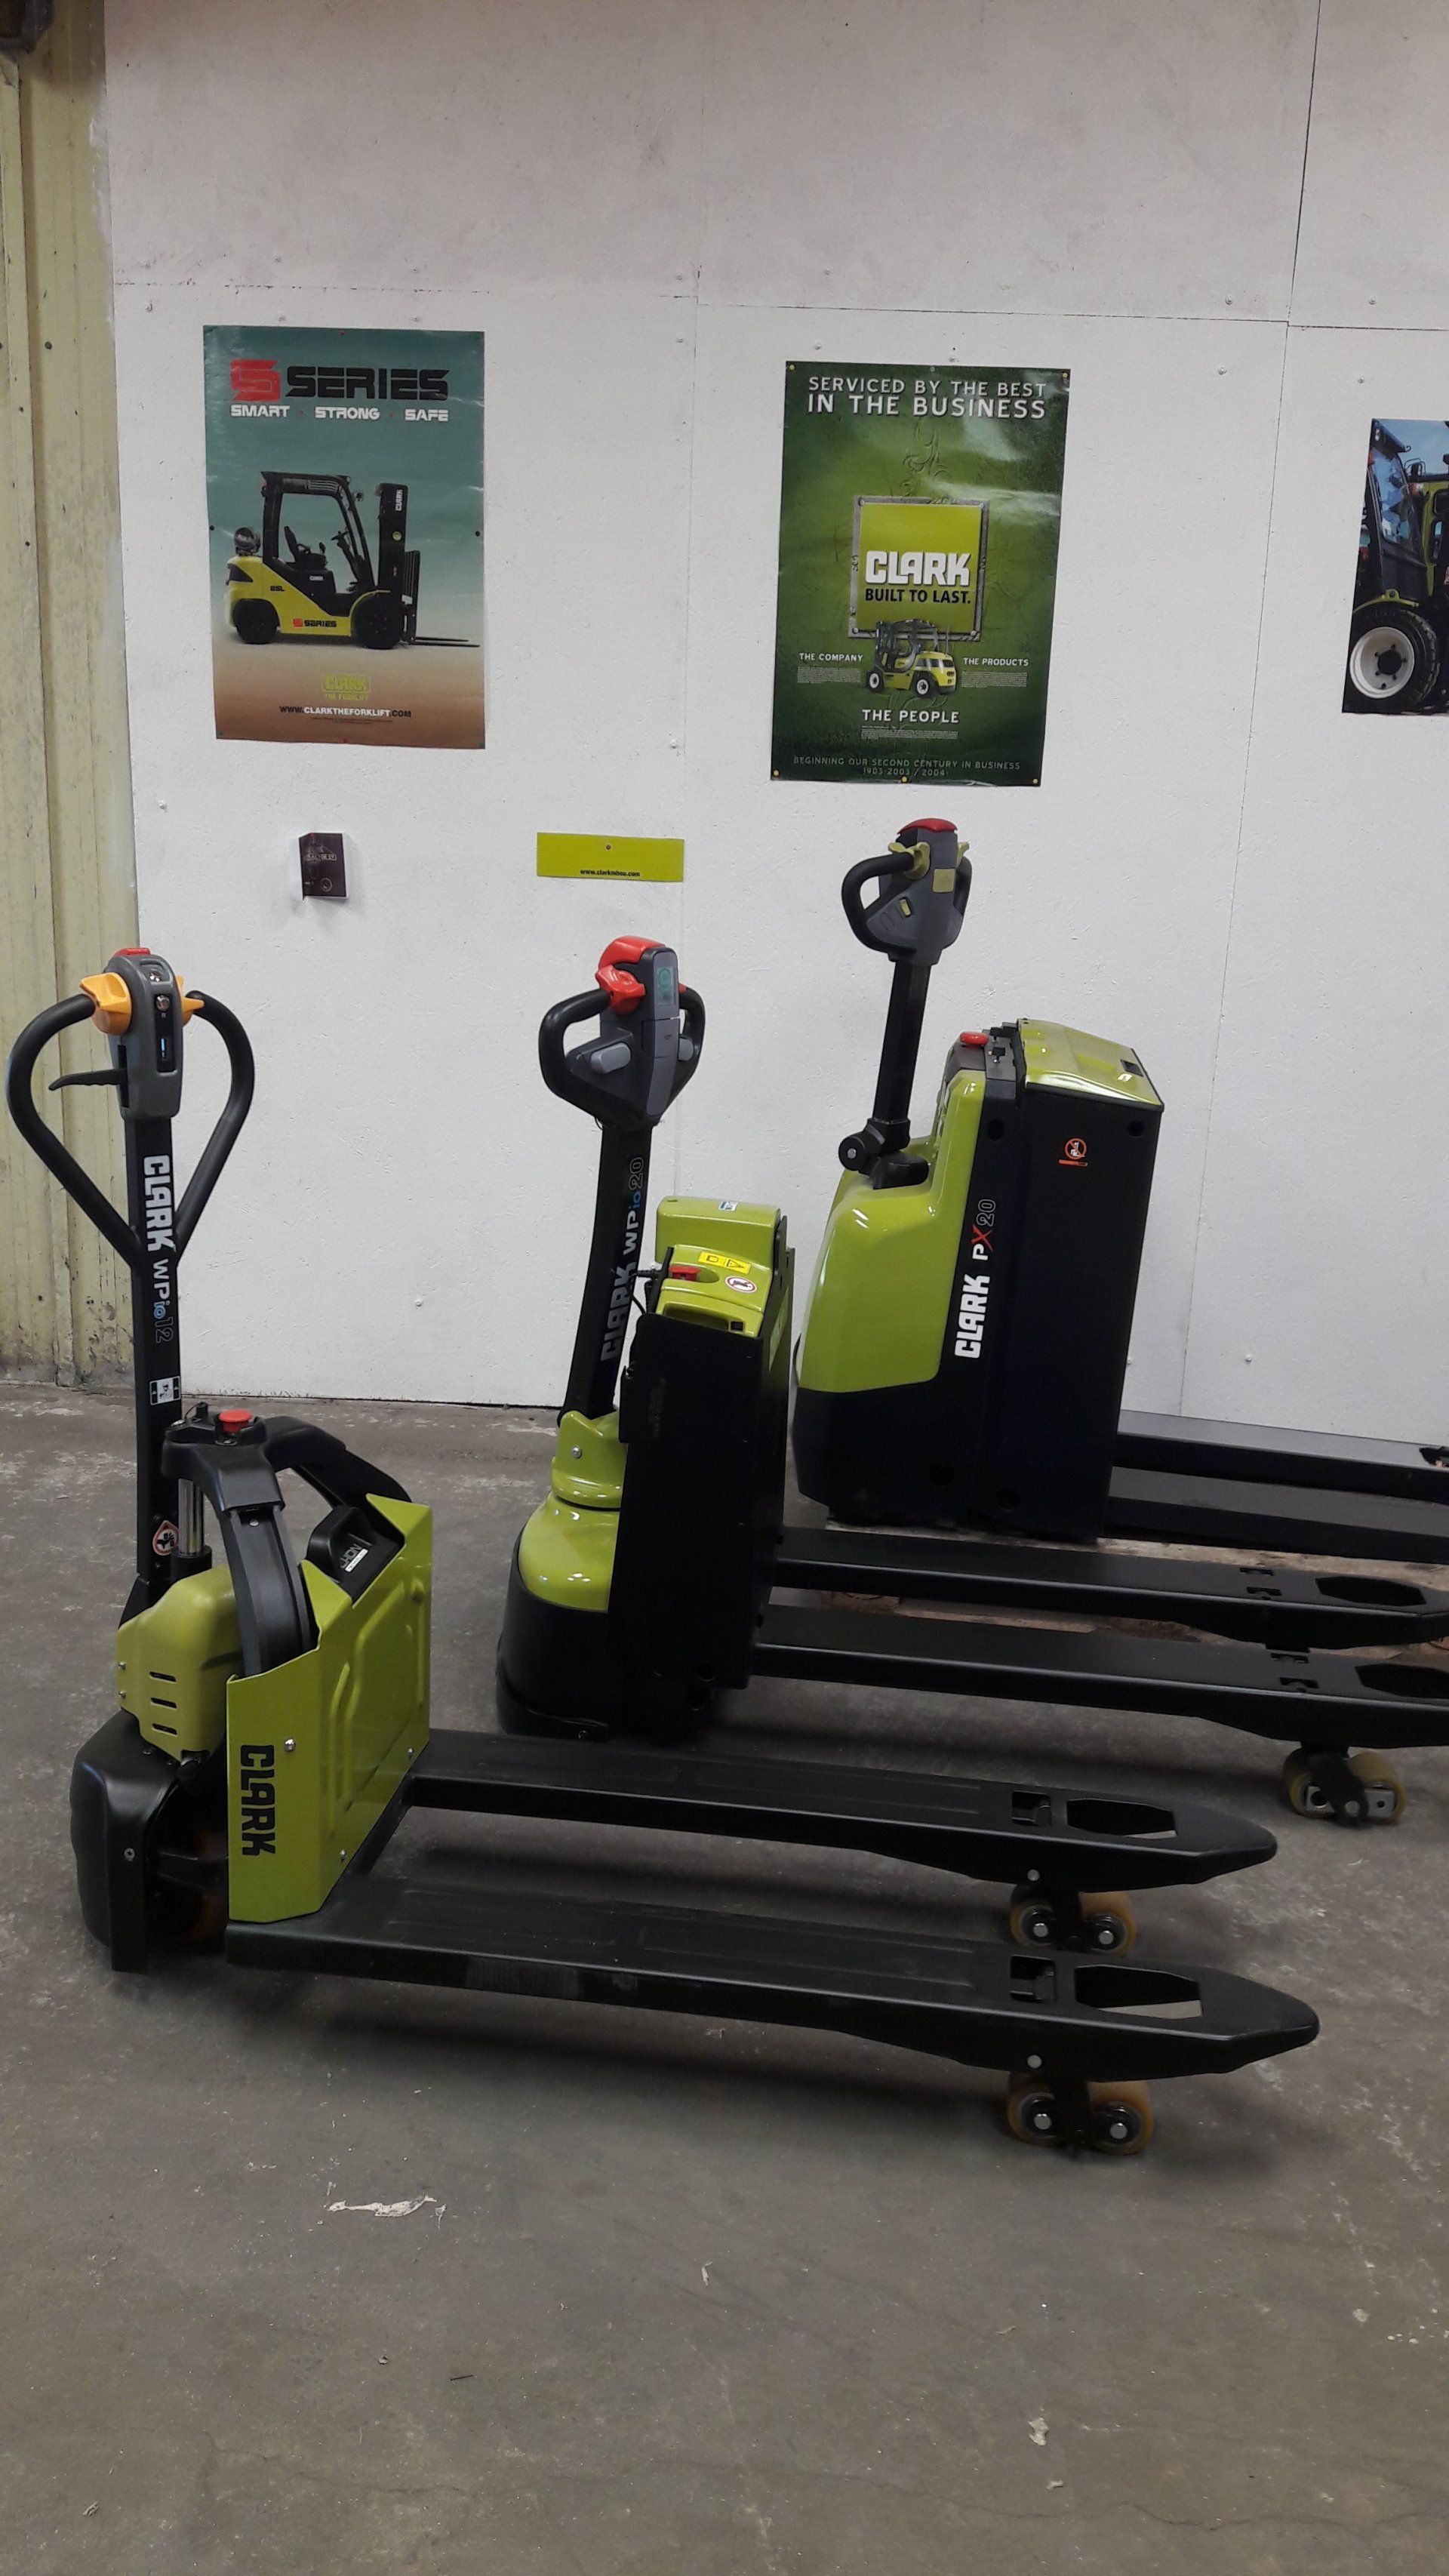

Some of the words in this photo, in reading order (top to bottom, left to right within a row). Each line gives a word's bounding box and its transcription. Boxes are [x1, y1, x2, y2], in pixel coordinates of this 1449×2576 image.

[285, 366, 450, 401] SERIES
[808, 377, 906, 394] SERVICED
[915, 380, 940, 395] BY
[951, 381, 989, 397] THE
[997, 383, 1047, 399] BEST
[230, 405, 291, 418] SMART
[315, 406, 380, 420] STRONG
[405, 408, 449, 422] SAFE
[808, 394, 834, 414] IN
[848, 395, 900, 416] THE
[912, 397, 1047, 419] BUSINESS
[865, 550, 971, 587] CLARK
[865, 588, 905, 602] BUILT
[909, 589, 928, 602] TO
[933, 590, 971, 604] LAST.
[799, 652, 816, 661] THE
[819, 653, 863, 662] COMPANY
[982, 658, 1029, 666] PRODUCTS
[279, 706, 412, 718] WWW.CLARKTHEFORKLIFT.COM
[862, 709, 892, 722] THE
[899, 710, 959, 723] PEOPLE
[793, 756, 844, 765] BEGINNING
[848, 757, 868, 766] OUR
[872, 759, 910, 767] SECOND
[913, 759, 958, 768] CENTURY
[974, 761, 1020, 770] BUSINESS
[143, 1155, 177, 1252] CLARK
[971, 1199, 996, 1261] PX20
[601, 1261, 637, 1362] CLARK
[954, 1273, 991, 1359] CLARK
[240, 1744, 276, 1856] CLARK
